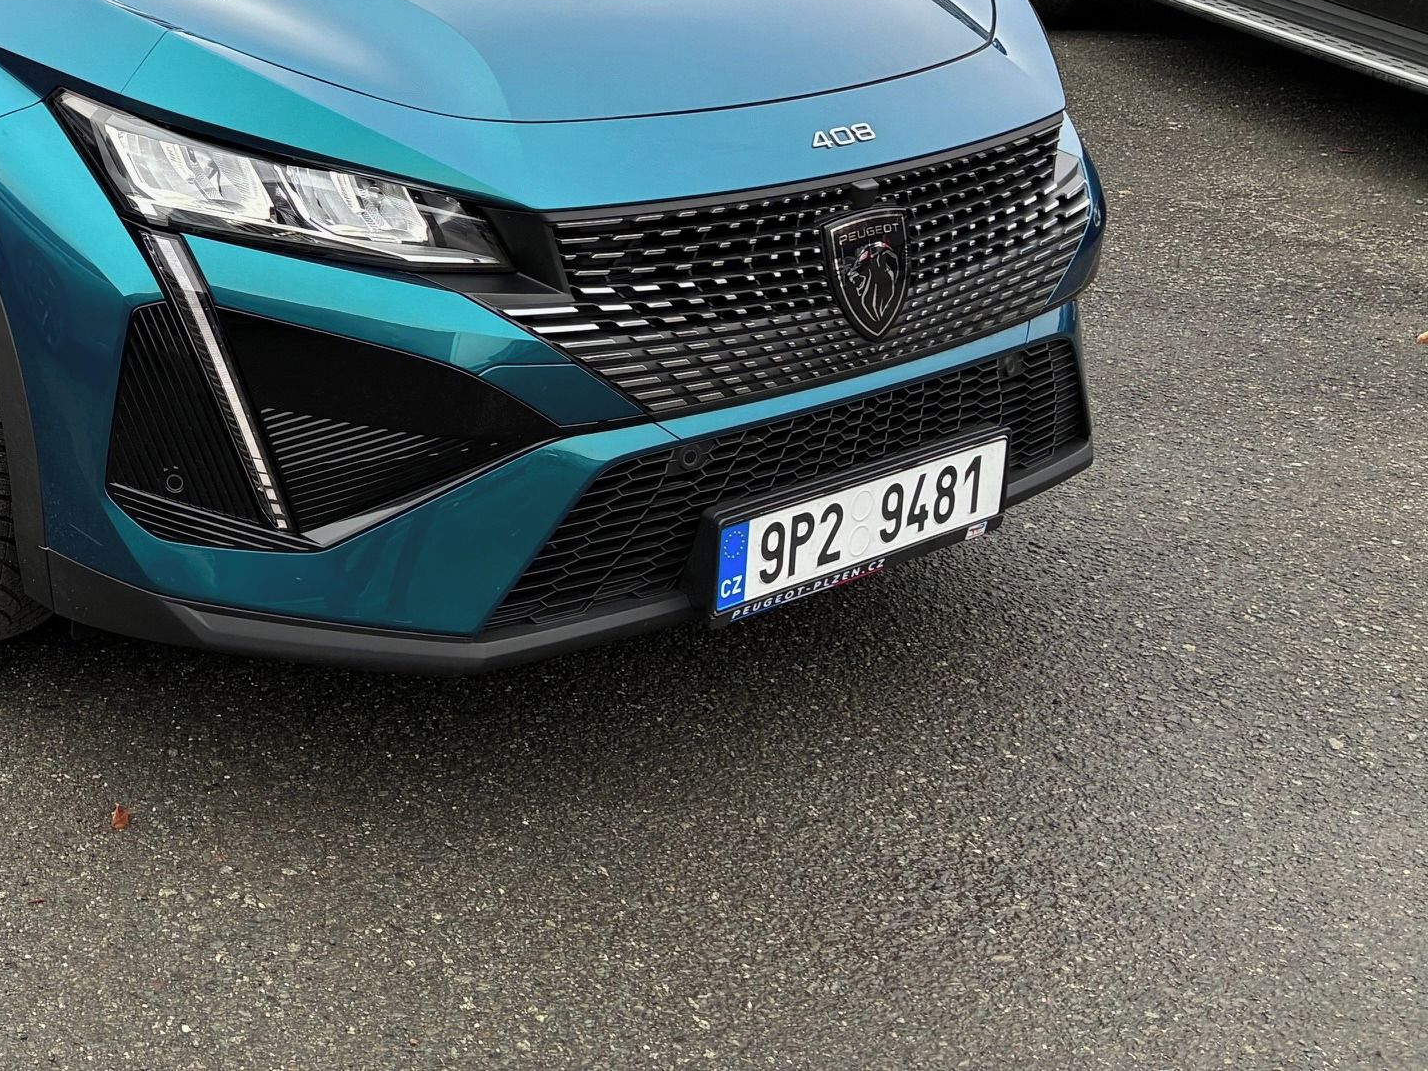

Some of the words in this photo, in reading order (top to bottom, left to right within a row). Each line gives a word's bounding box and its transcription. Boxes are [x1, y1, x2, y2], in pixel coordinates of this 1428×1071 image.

[812, 122, 877, 150] 408
[838, 222, 900, 246] PEUGEOT
[720, 574, 743, 599] CZ
[758, 503, 844, 585] 9P2
[879, 455, 983, 544] 9481
[731, 558, 886, 619] PEUGEOT-PLZEN.CZ
